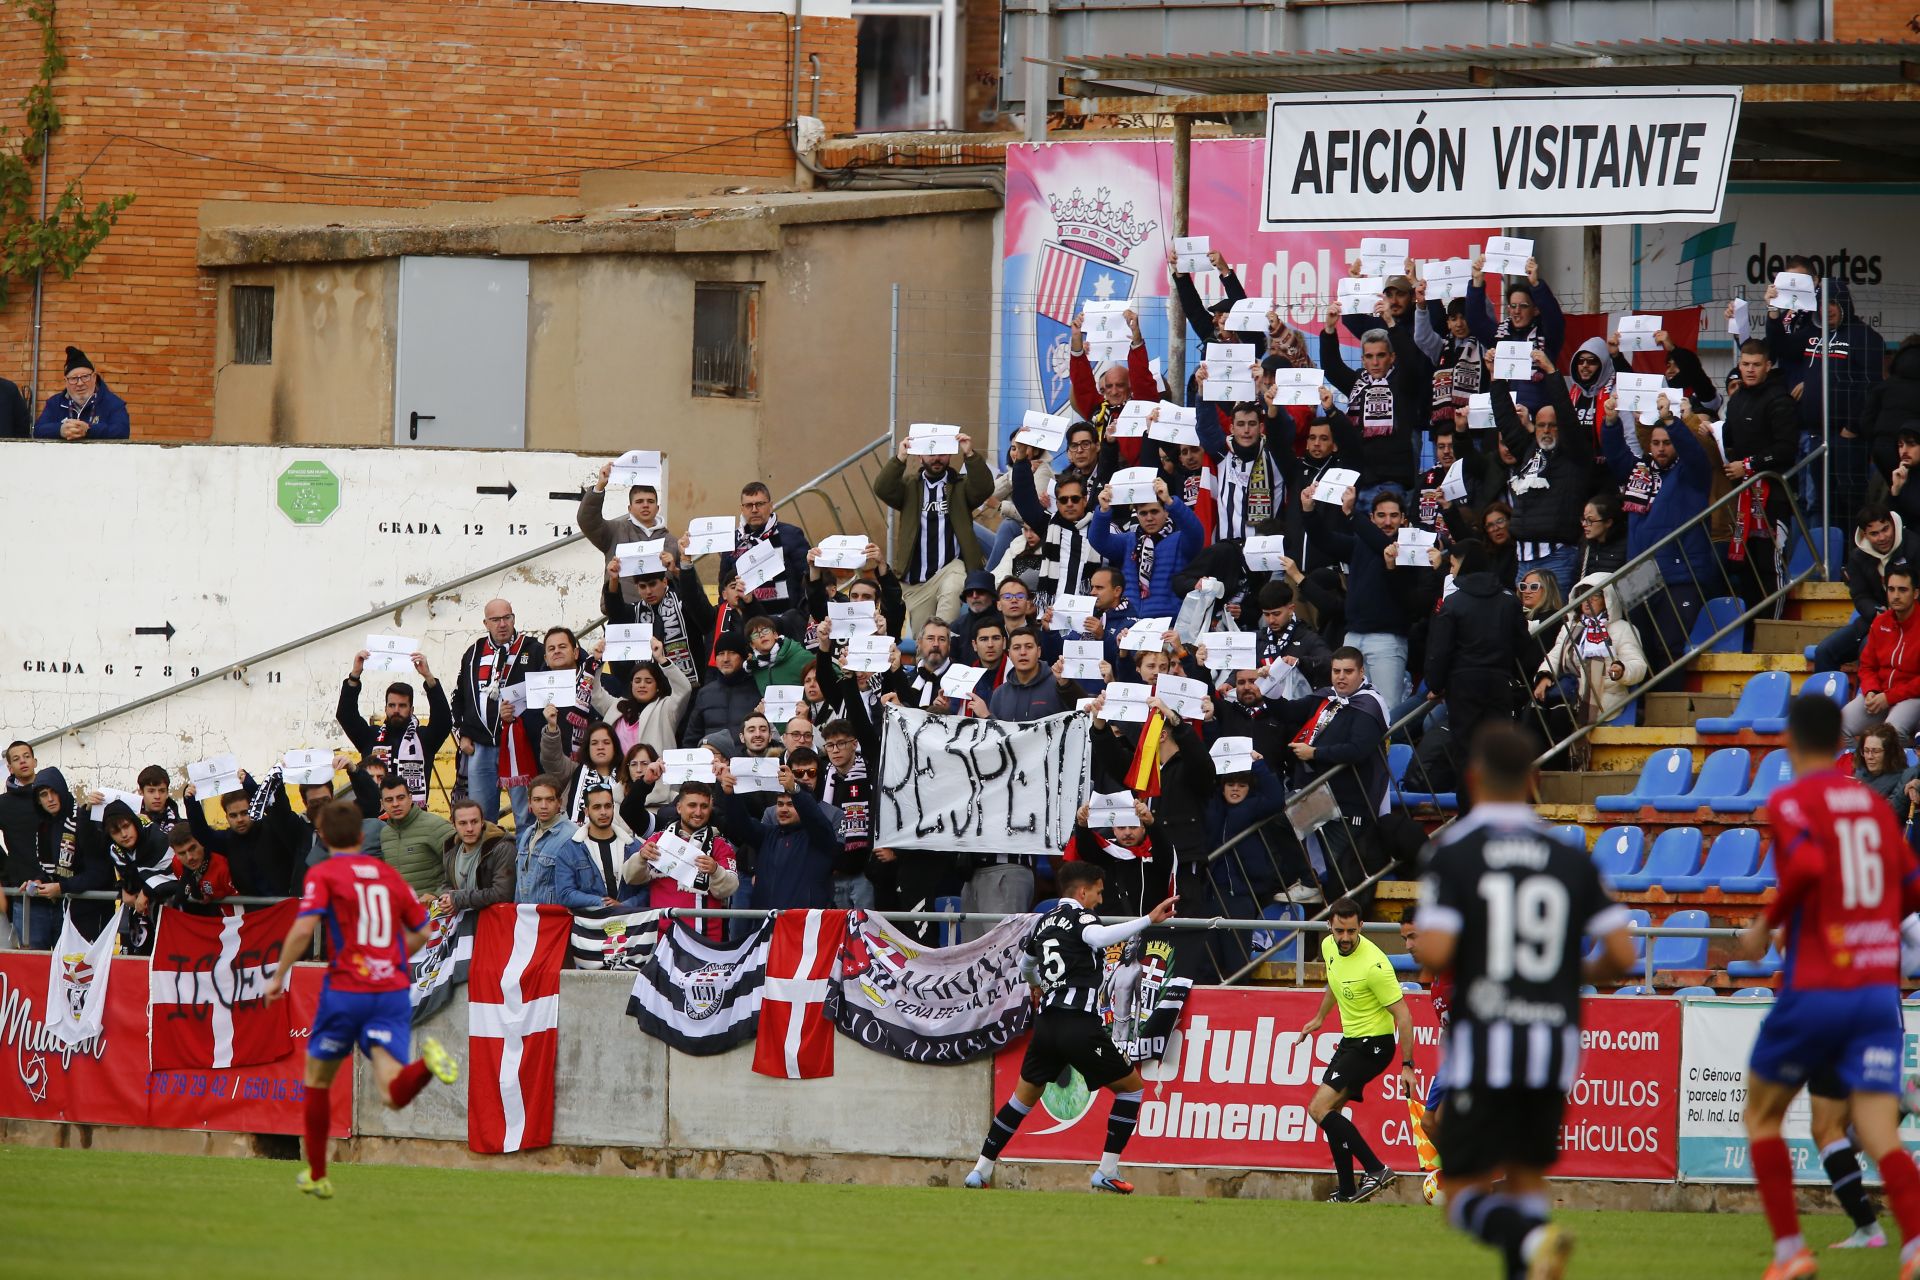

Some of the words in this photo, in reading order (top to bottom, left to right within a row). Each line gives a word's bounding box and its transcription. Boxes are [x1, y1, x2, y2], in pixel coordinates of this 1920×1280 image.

[1291, 110, 1466, 195] AFICIÓN
[1492, 122, 1707, 191] VISITANTE
[1747, 242, 1882, 286] deortes
[378, 522, 442, 534] GRADA
[463, 524, 484, 536] 12
[507, 524, 527, 536] 13
[552, 526, 573, 537] 14
[23, 660, 84, 674] GRADA
[104, 664, 114, 675] 6
[134, 665, 143, 677] 7
[163, 665, 172, 677] 8
[190, 666, 200, 678] 9
[266, 671, 281, 683] 11
[1834, 817, 1884, 910] 16
[353, 882, 392, 948] 10
[1477, 871, 1570, 983] 19
[1042, 938, 1066, 982] 5
[1565, 1073, 1659, 1107] ÓTULOS
[1703, 1067, 1742, 1082] Génova
[1688, 1089, 1727, 1103] parcela
[1688, 1109, 1705, 1122] Pol.
[1707, 1109, 1725, 1122] Ind.
[1729, 1109, 1740, 1122] La
